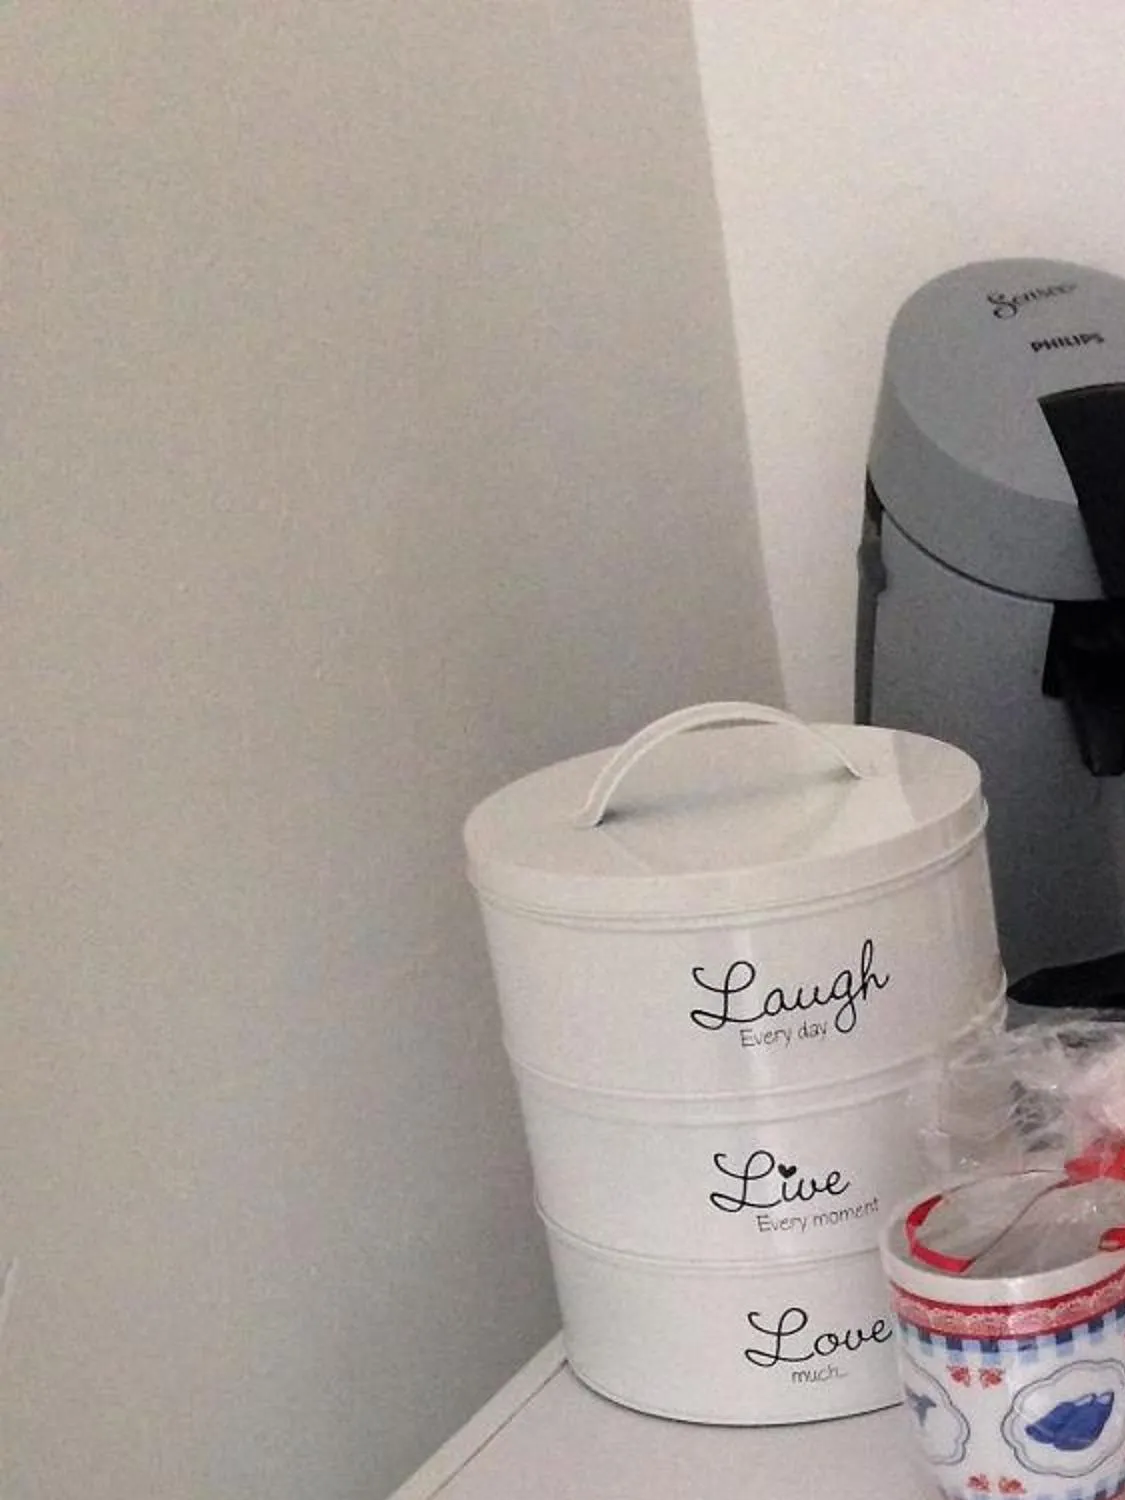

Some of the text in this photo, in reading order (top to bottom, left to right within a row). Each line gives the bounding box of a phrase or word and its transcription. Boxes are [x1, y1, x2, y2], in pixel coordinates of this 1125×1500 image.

[1030, 332, 1105, 353] PHILIPS
[690, 939, 890, 1034] Laugh
[739, 1019, 828, 1048] Every day
[709, 1150, 850, 1213] Live
[756, 1197, 880, 1233] Every moment
[744, 1307, 893, 1368] Love
